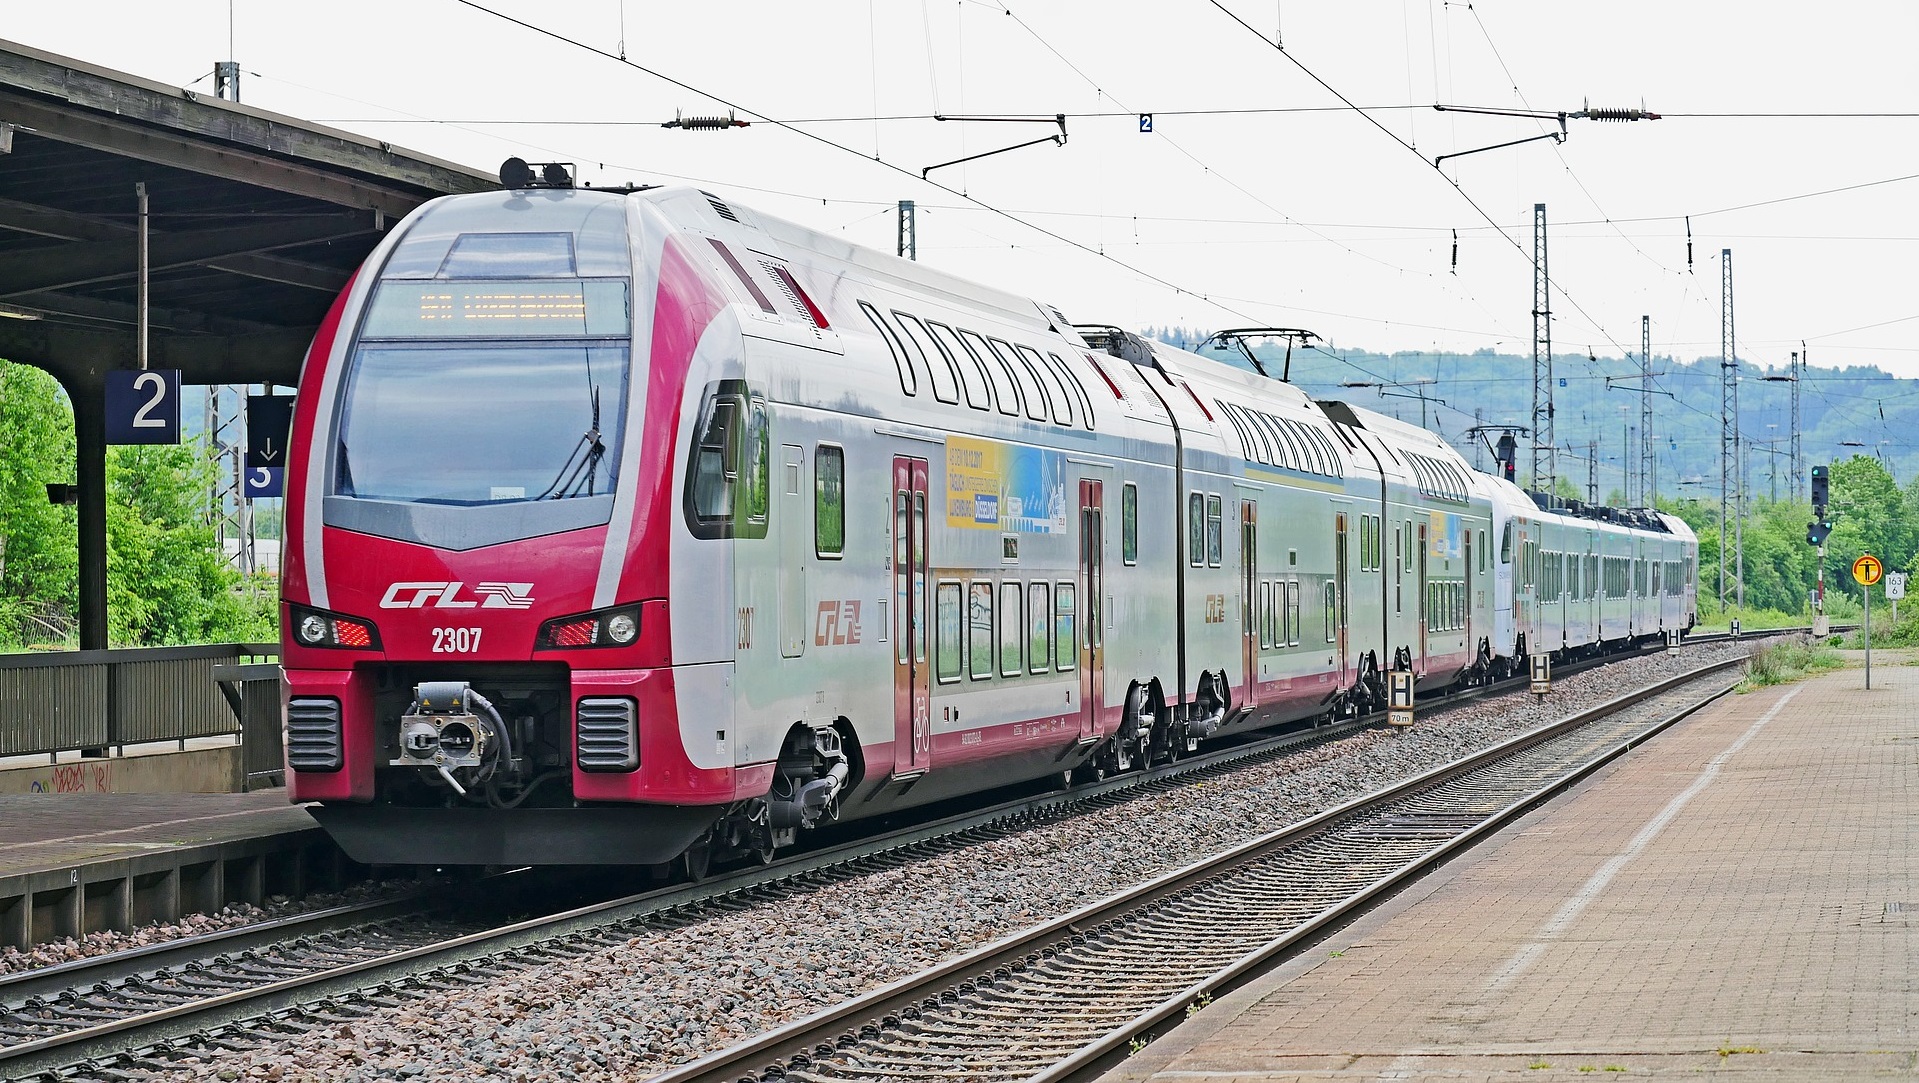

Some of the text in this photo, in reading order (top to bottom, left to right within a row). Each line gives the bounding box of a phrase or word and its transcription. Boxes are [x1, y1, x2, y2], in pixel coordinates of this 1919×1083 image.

[1141, 115, 1151, 131] 2
[132, 372, 167, 428] 2
[249, 467, 272, 488] 3
[1888, 577, 1902, 585] 163
[1892, 586, 1898, 595] 6
[737, 607, 755, 649] 2307
[1668, 629, 1679, 645] H
[1730, 621, 1740, 635] H
[431, 627, 483, 653] 2307
[1532, 656, 1548, 680] H
[1390, 675, 1411, 706] H
[1391, 714, 1401, 722] 70
